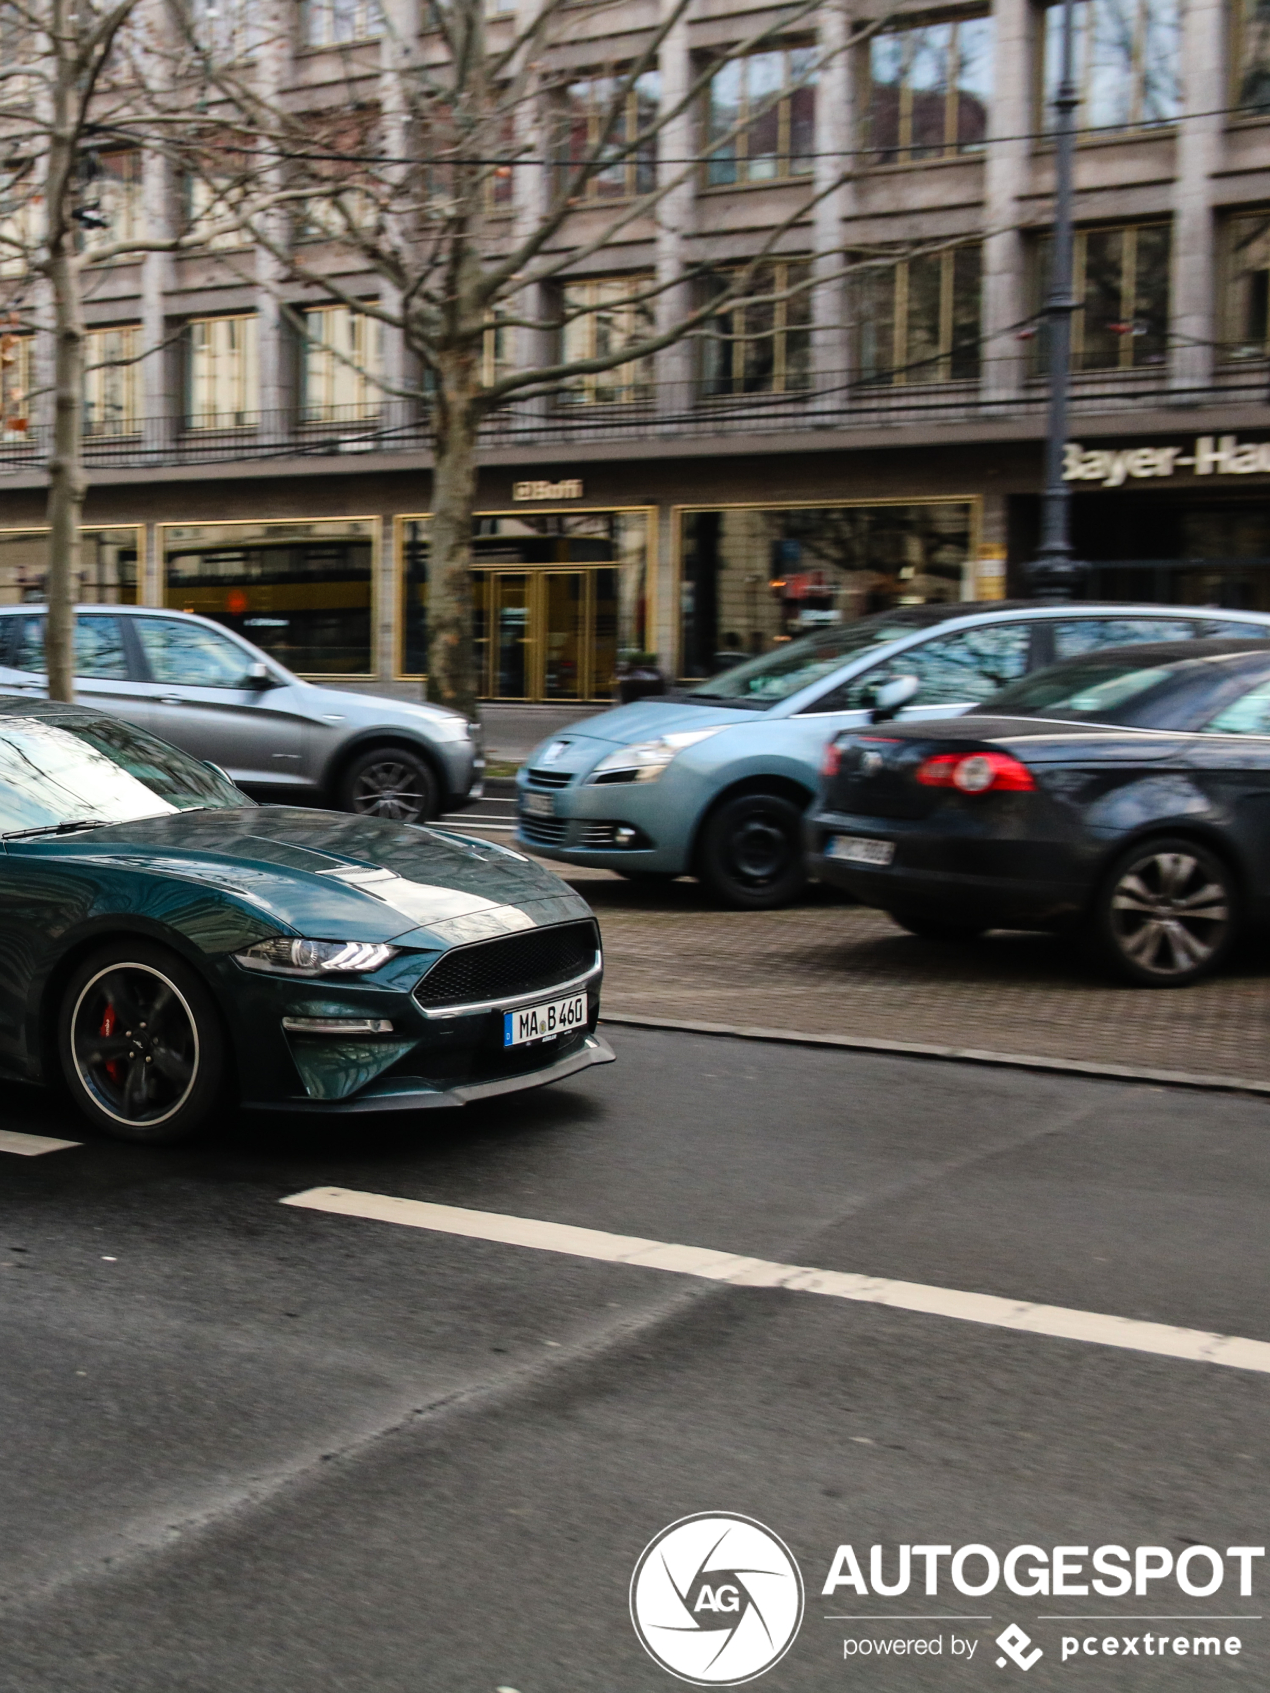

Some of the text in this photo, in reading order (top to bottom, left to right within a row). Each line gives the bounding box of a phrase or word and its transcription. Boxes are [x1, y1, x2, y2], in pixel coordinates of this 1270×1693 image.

[519, 997, 583, 1039] MA B 460
